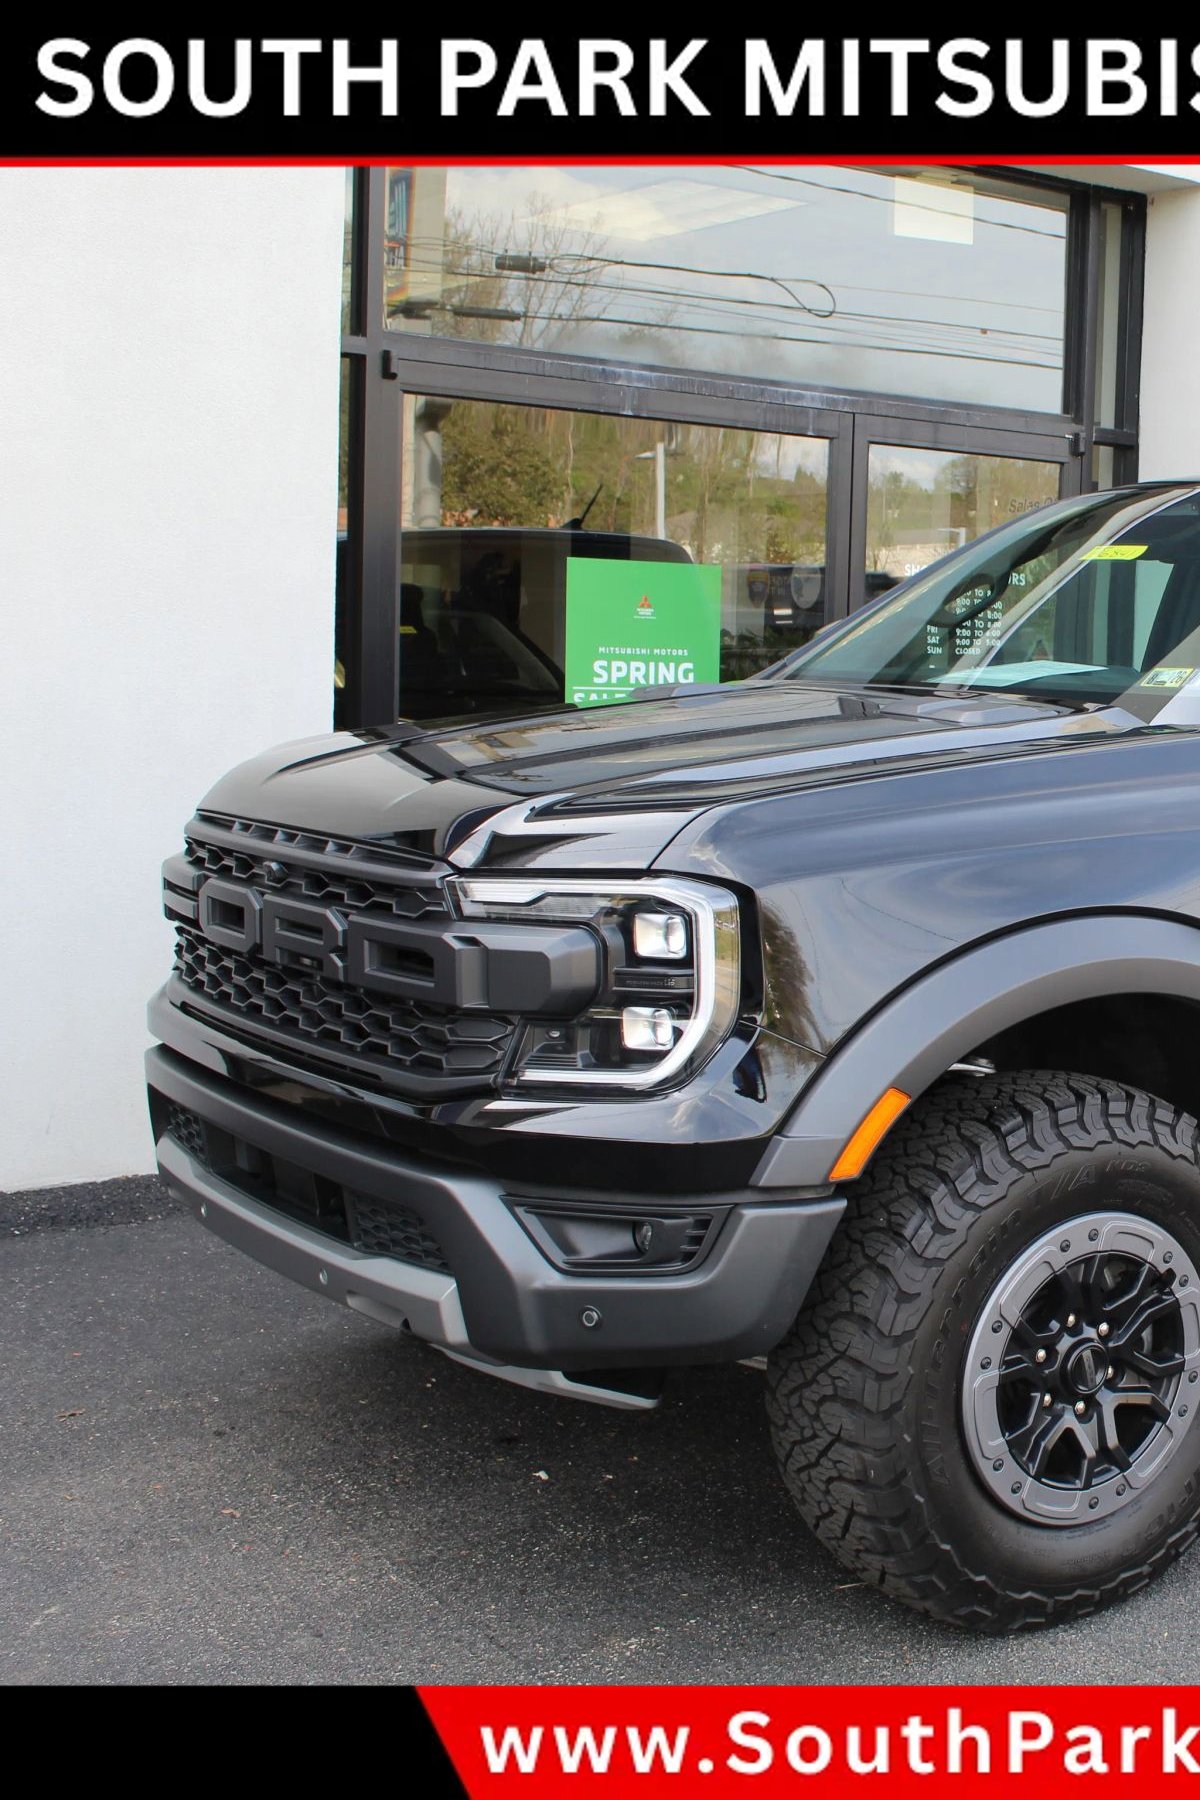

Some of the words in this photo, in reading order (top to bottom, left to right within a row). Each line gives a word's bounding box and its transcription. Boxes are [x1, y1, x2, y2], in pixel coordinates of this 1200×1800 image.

[926, 636, 940, 645] SAT
[598, 647, 650, 655] MITSUBISHI
[926, 646, 943, 655] SUN
[593, 660, 695, 685] SPRING
